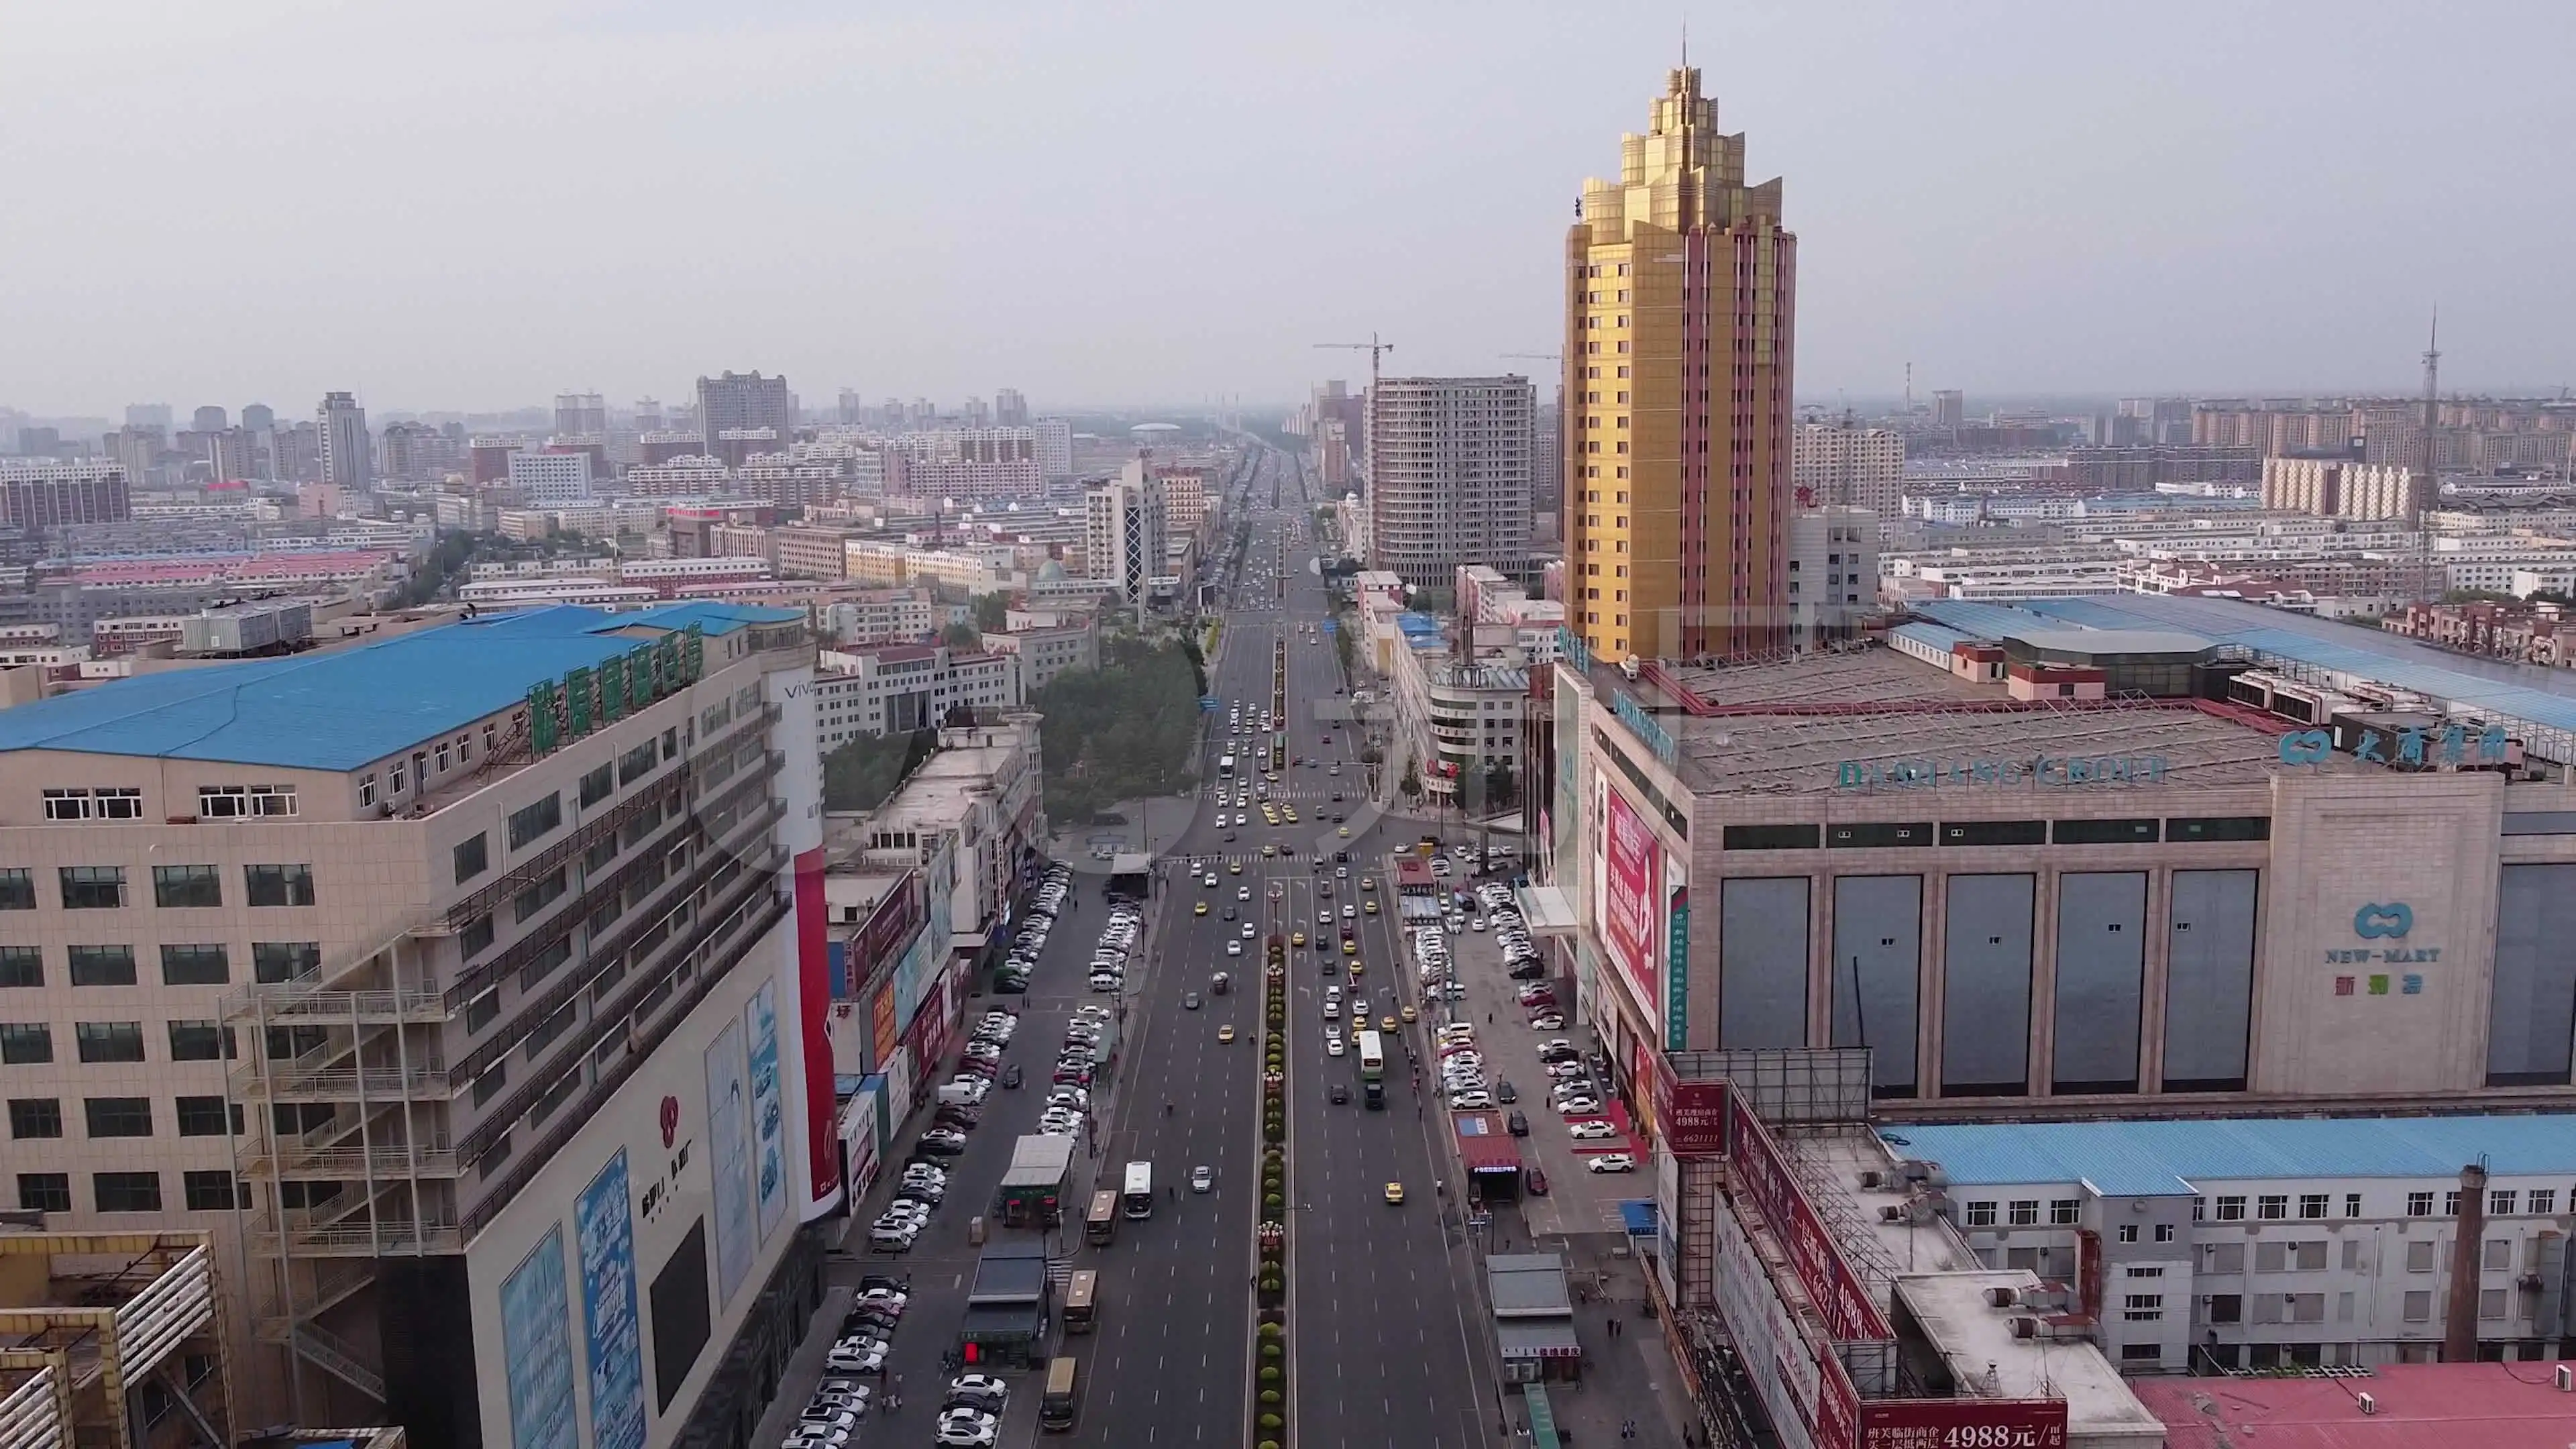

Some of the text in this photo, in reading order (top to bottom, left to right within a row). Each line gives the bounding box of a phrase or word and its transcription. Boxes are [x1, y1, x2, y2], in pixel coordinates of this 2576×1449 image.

[785, 680, 814, 698] vivo
[1839, 755, 2167, 788] DASHANG GROUP
[2325, 948, 2442, 964] NEW-MART
